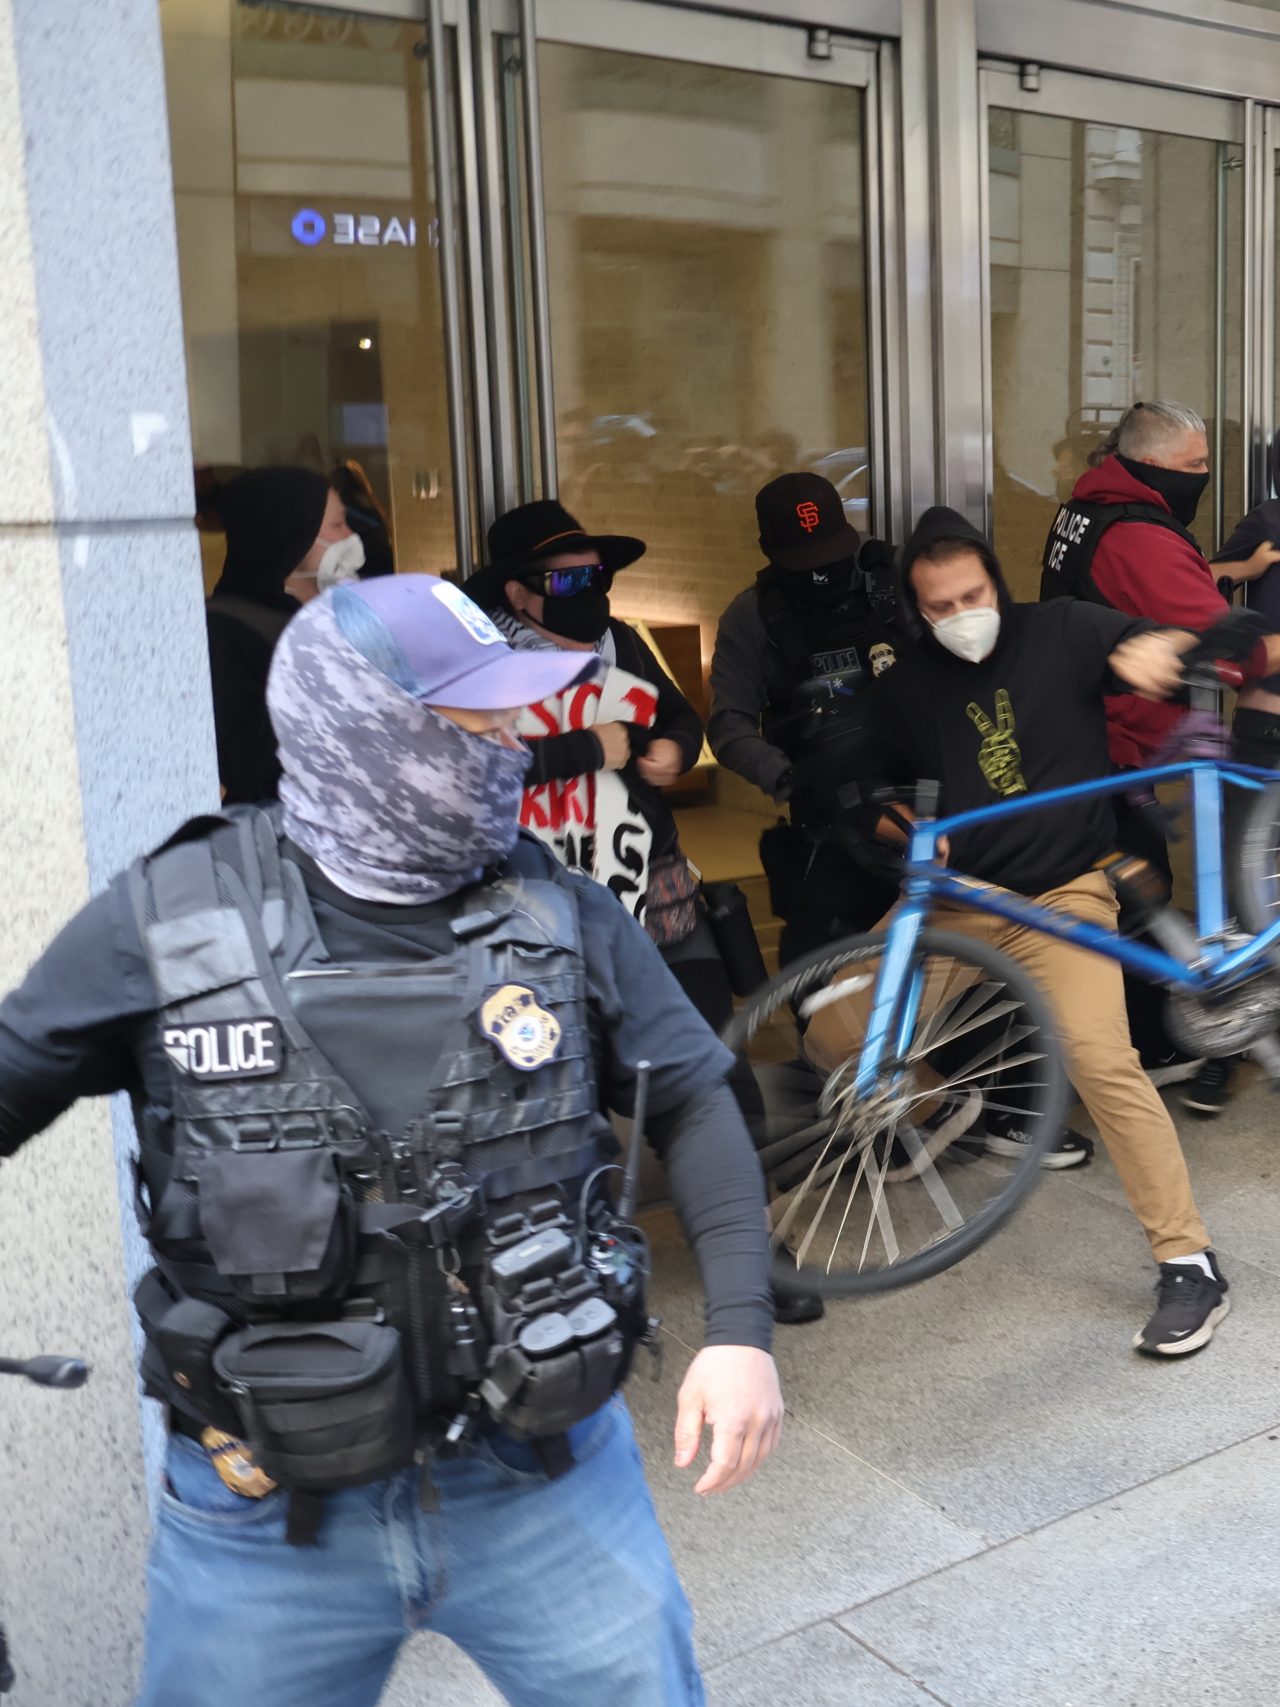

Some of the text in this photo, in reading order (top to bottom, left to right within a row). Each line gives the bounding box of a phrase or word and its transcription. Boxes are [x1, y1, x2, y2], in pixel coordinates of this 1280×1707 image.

[1048, 540, 1068, 572] ICE
[814, 651, 855, 673] POLICE
[164, 1021, 275, 1074] POLICE
